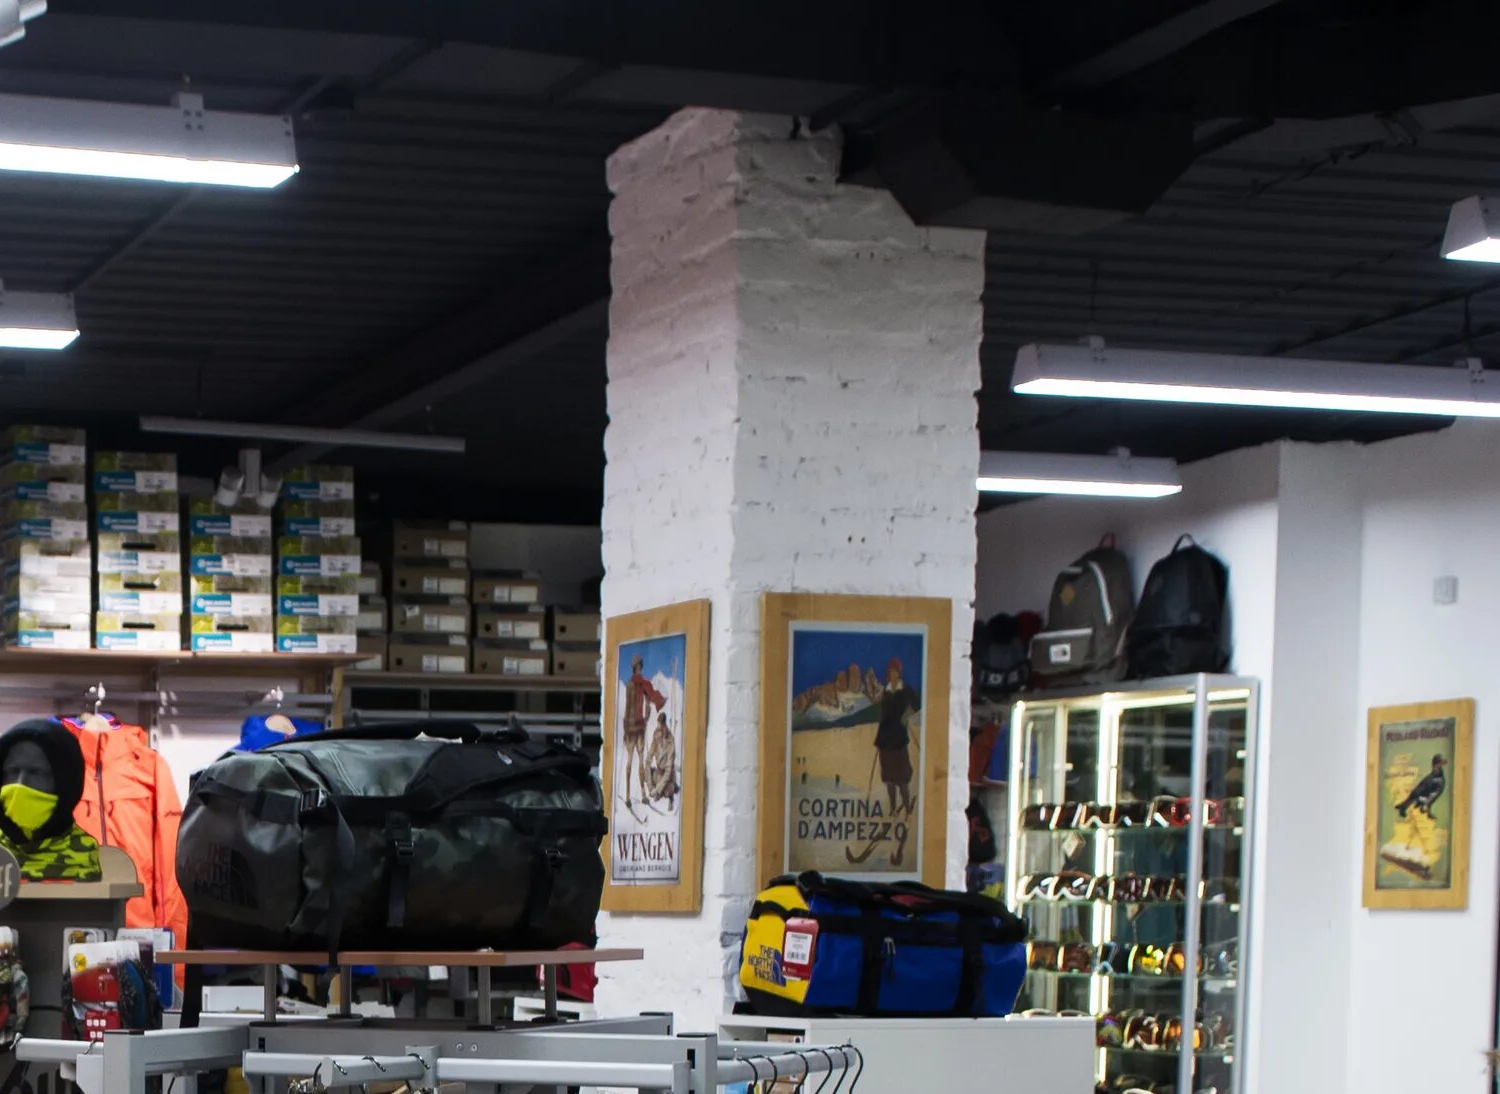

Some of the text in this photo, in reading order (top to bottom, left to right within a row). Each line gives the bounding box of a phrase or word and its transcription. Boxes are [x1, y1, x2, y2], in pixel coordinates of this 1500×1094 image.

[798, 799, 884, 818] CORTINA
[797, 820, 908, 841] D'AMPEZZO
[617, 832, 675, 862] WENGEN
